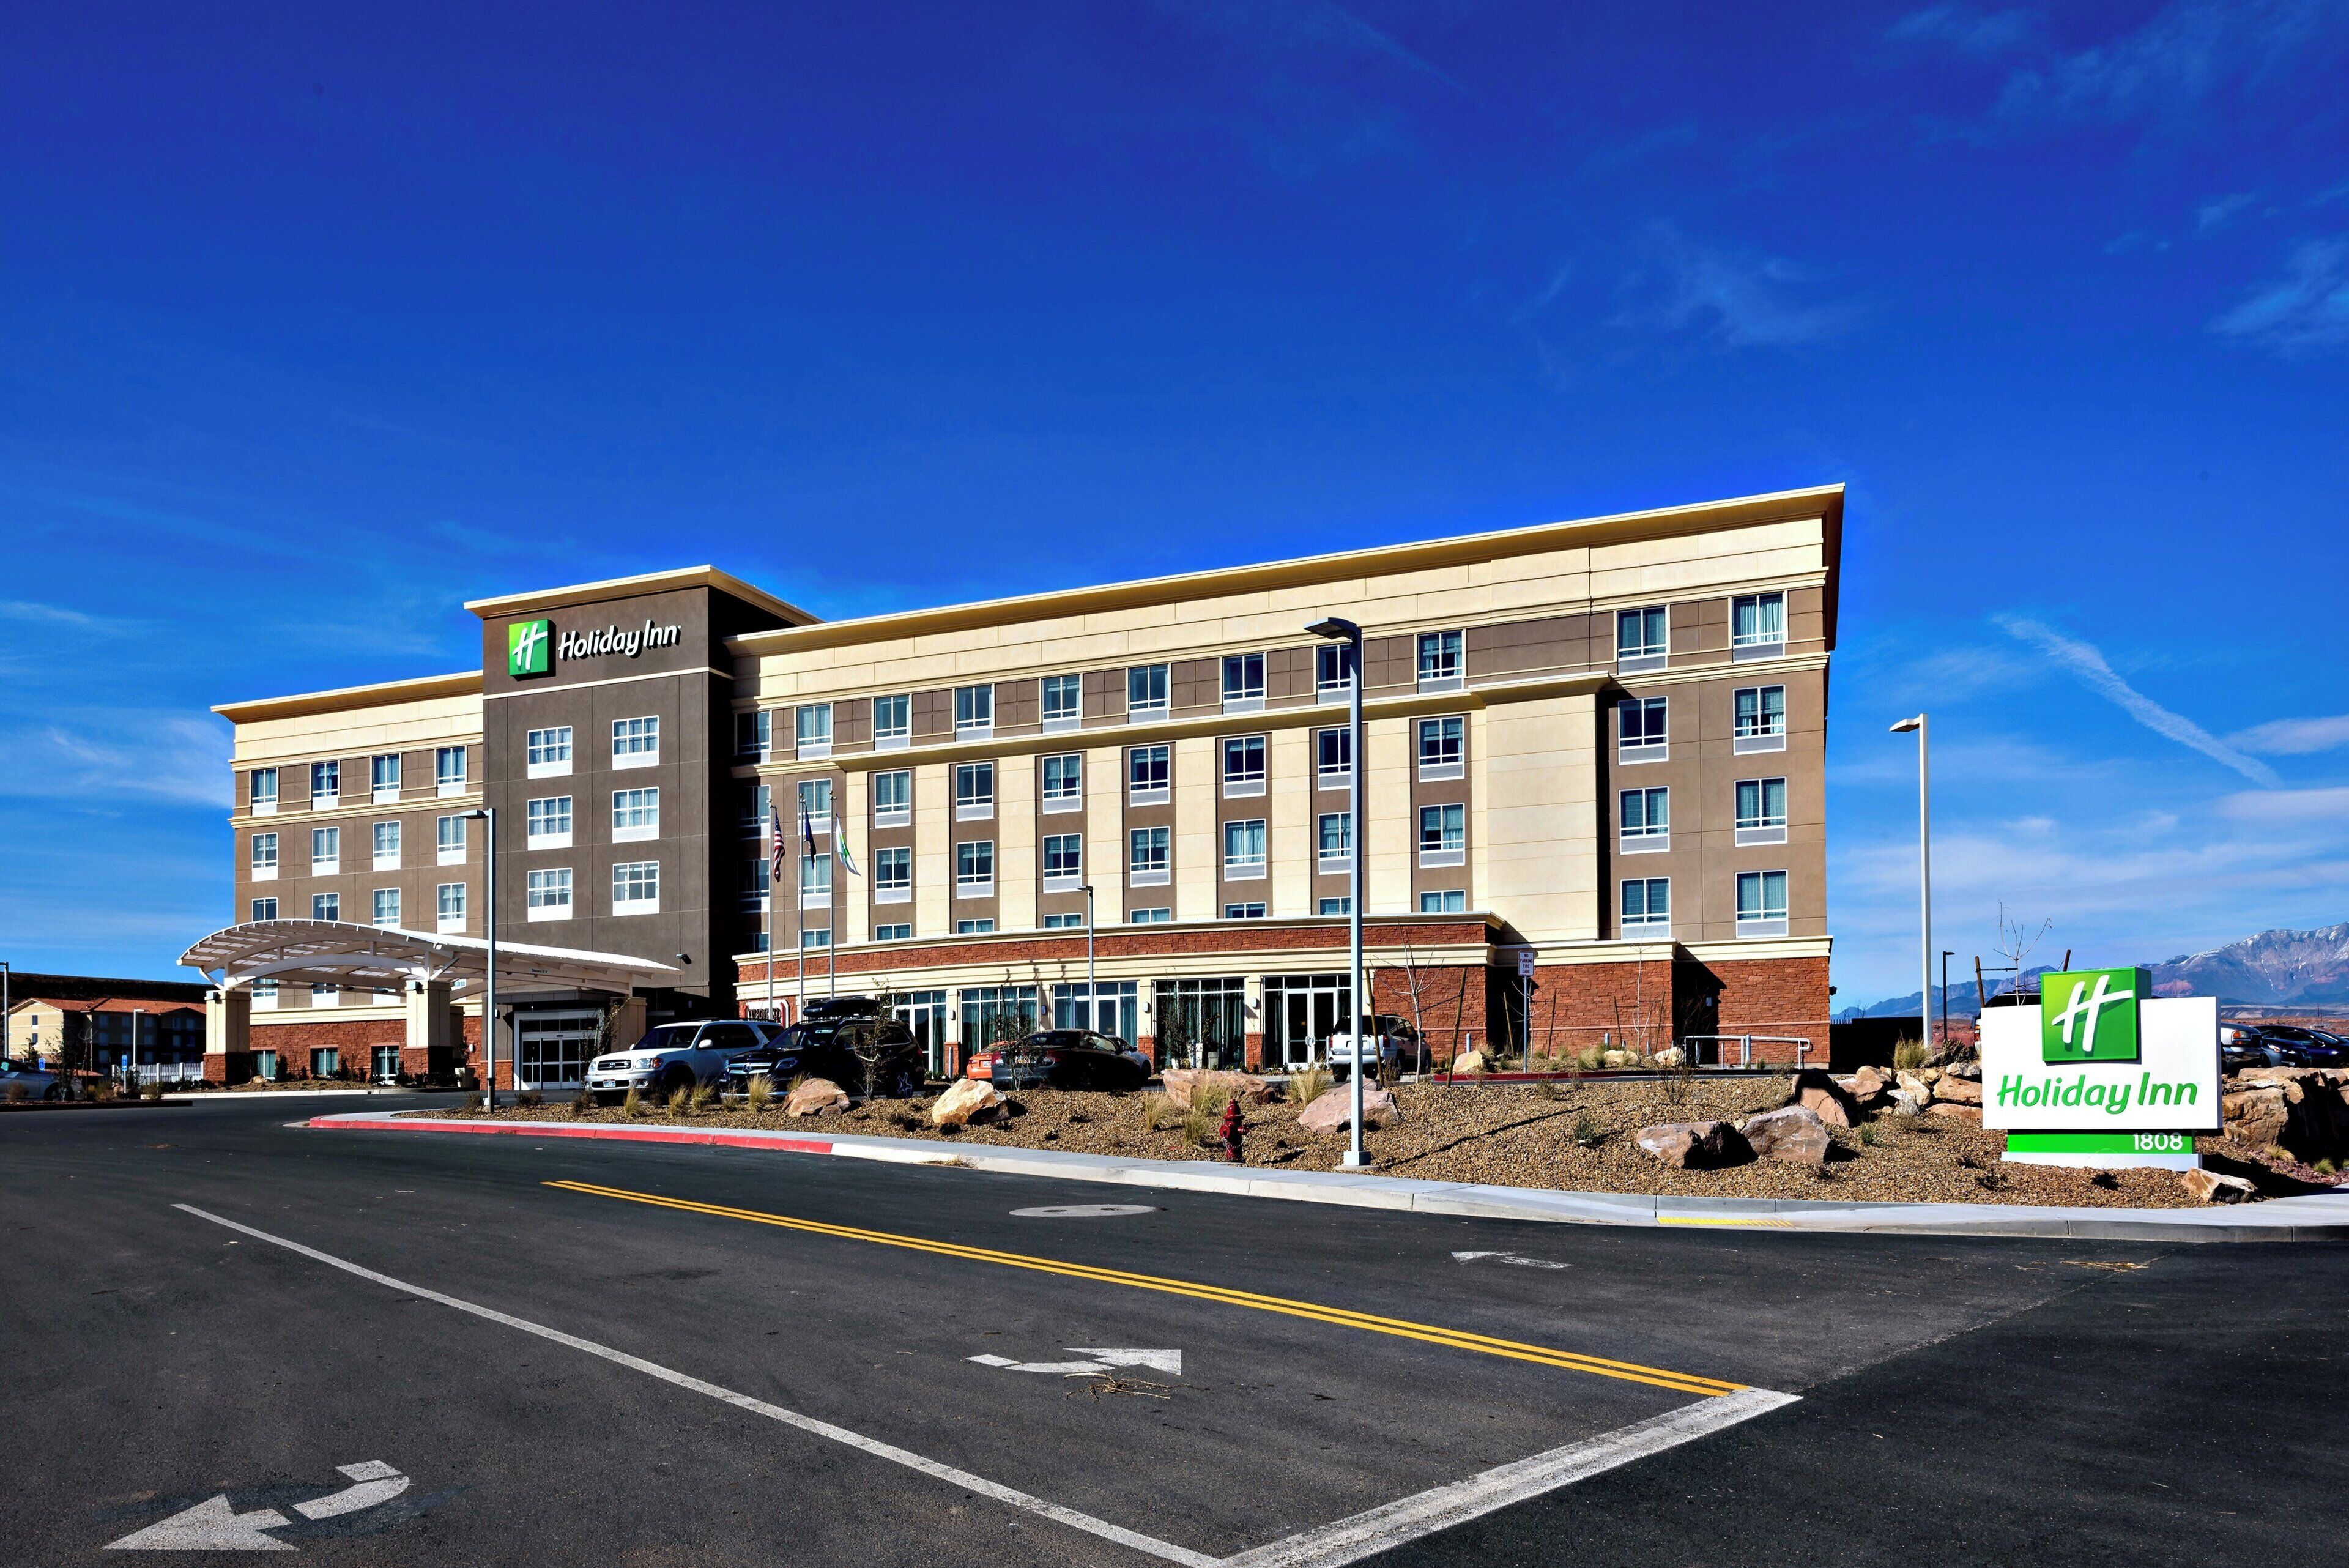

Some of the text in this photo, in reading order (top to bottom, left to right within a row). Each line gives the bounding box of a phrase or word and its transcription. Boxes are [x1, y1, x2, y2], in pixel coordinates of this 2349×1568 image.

[557, 619, 677, 660] Holiday Inn
[1997, 1072, 2198, 1114] Holiday Inn
[2132, 1132, 2183, 1150] 1808
